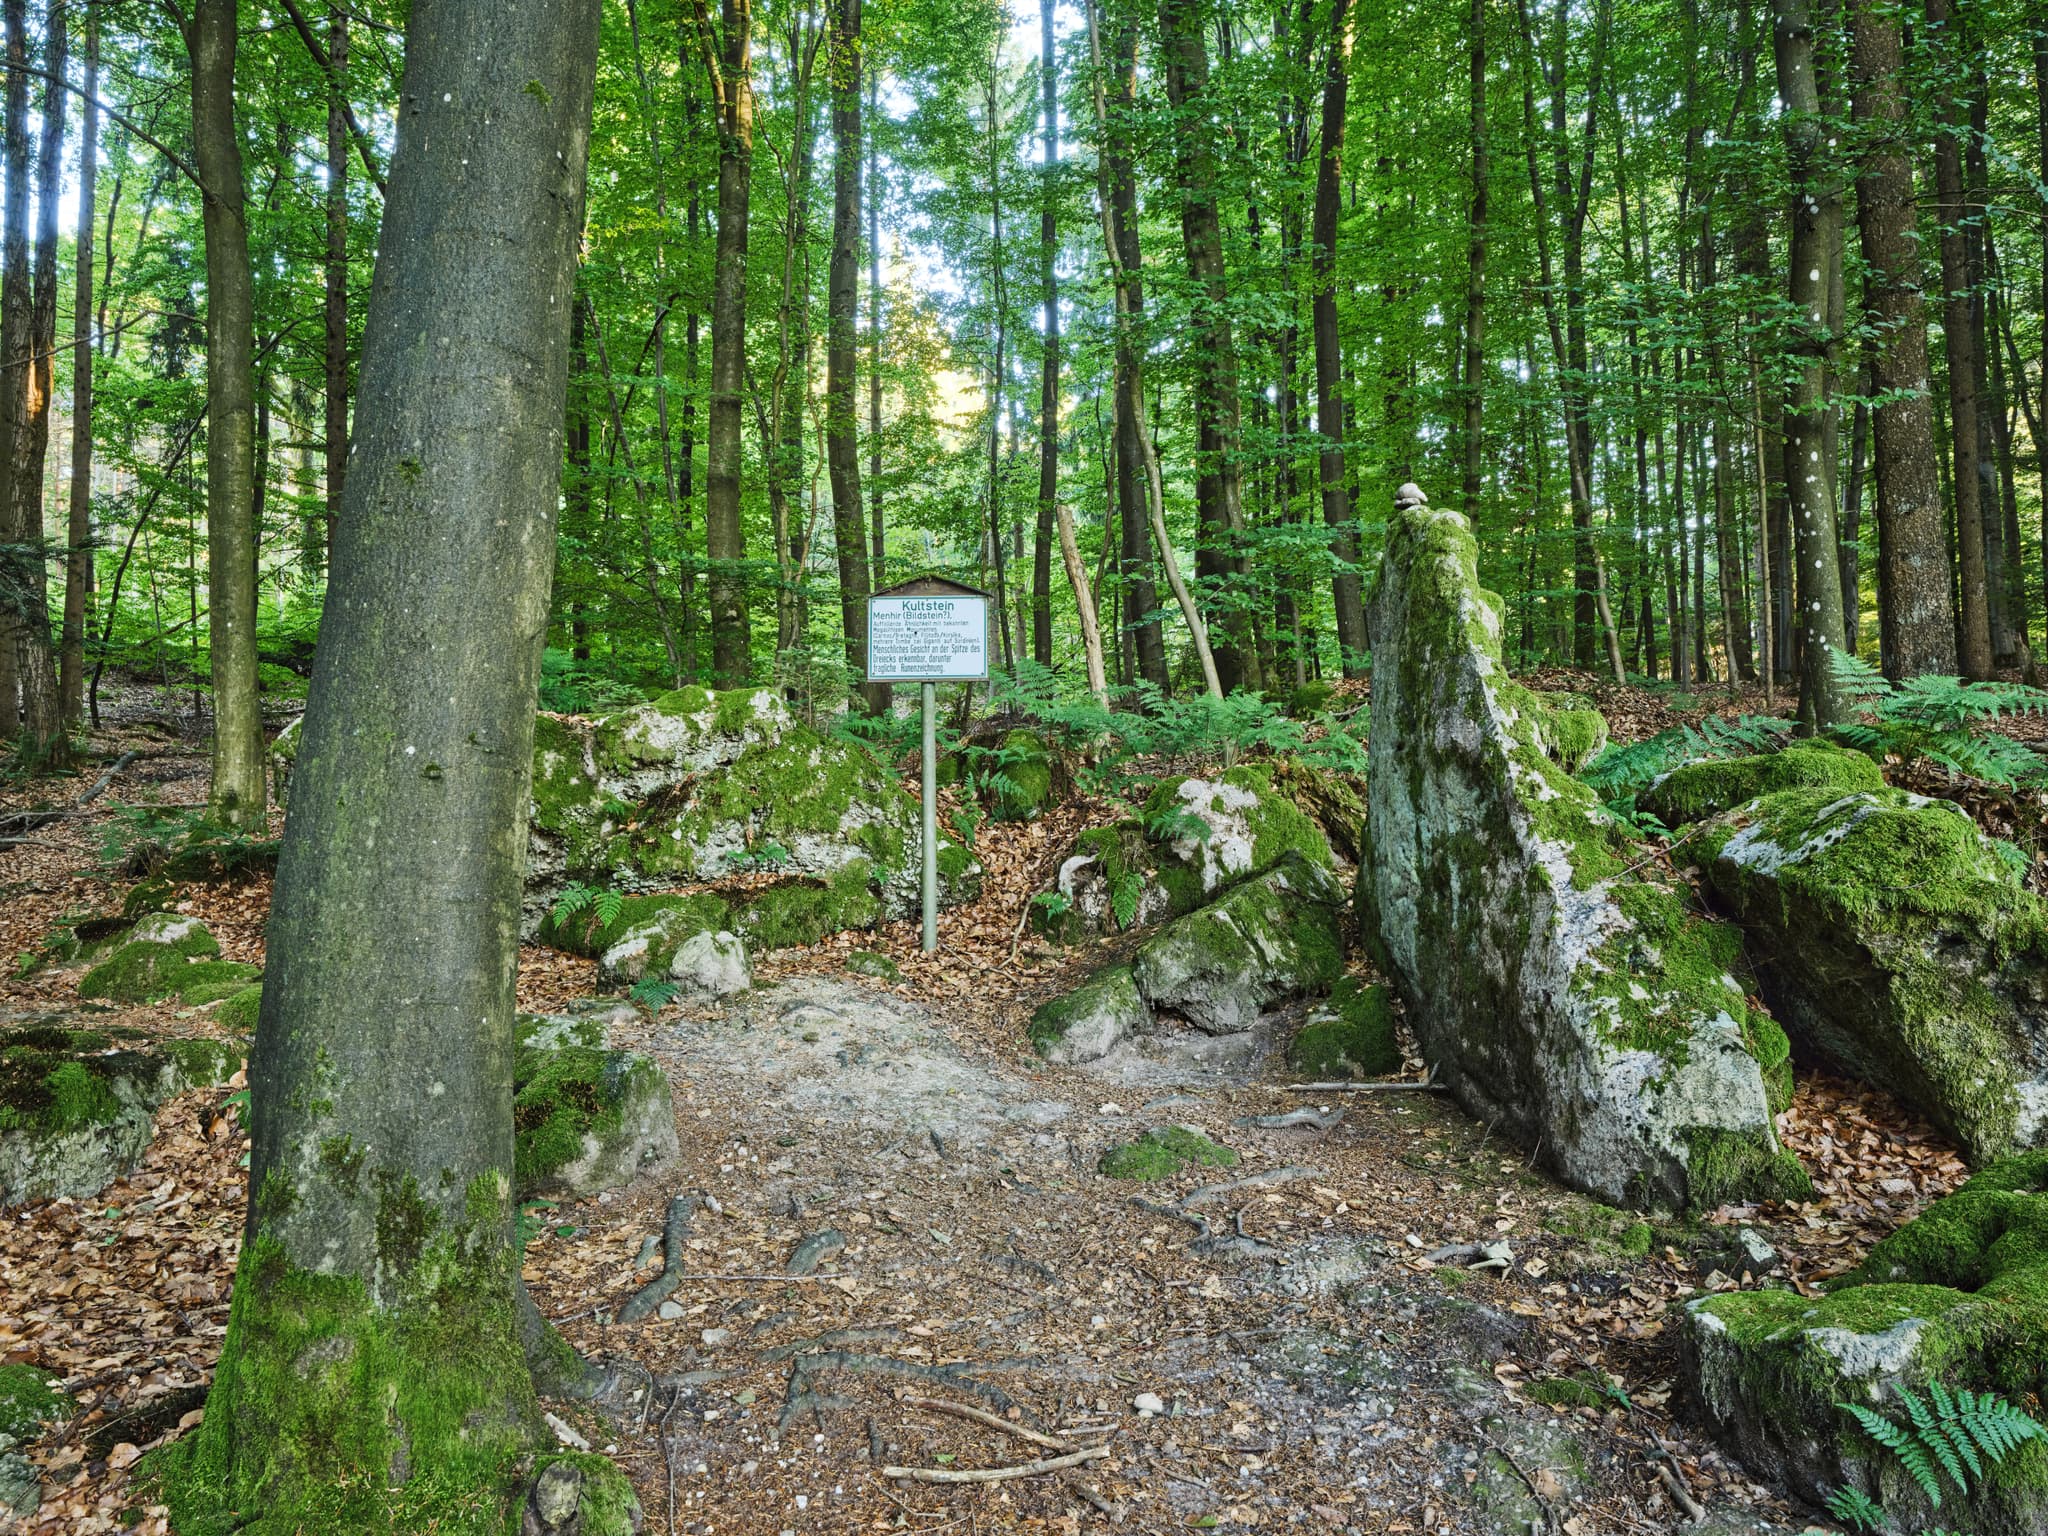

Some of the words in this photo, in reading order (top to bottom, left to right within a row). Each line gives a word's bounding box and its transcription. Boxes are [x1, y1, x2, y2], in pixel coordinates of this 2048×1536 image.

[902, 601, 954, 611] Kultstein
[873, 645, 908, 653] Menschliches
[910, 645, 930, 653] Gesicht
[940, 645, 949, 653] der
[951, 645, 968, 654] Spitze
[873, 664, 896, 674] fragliche
